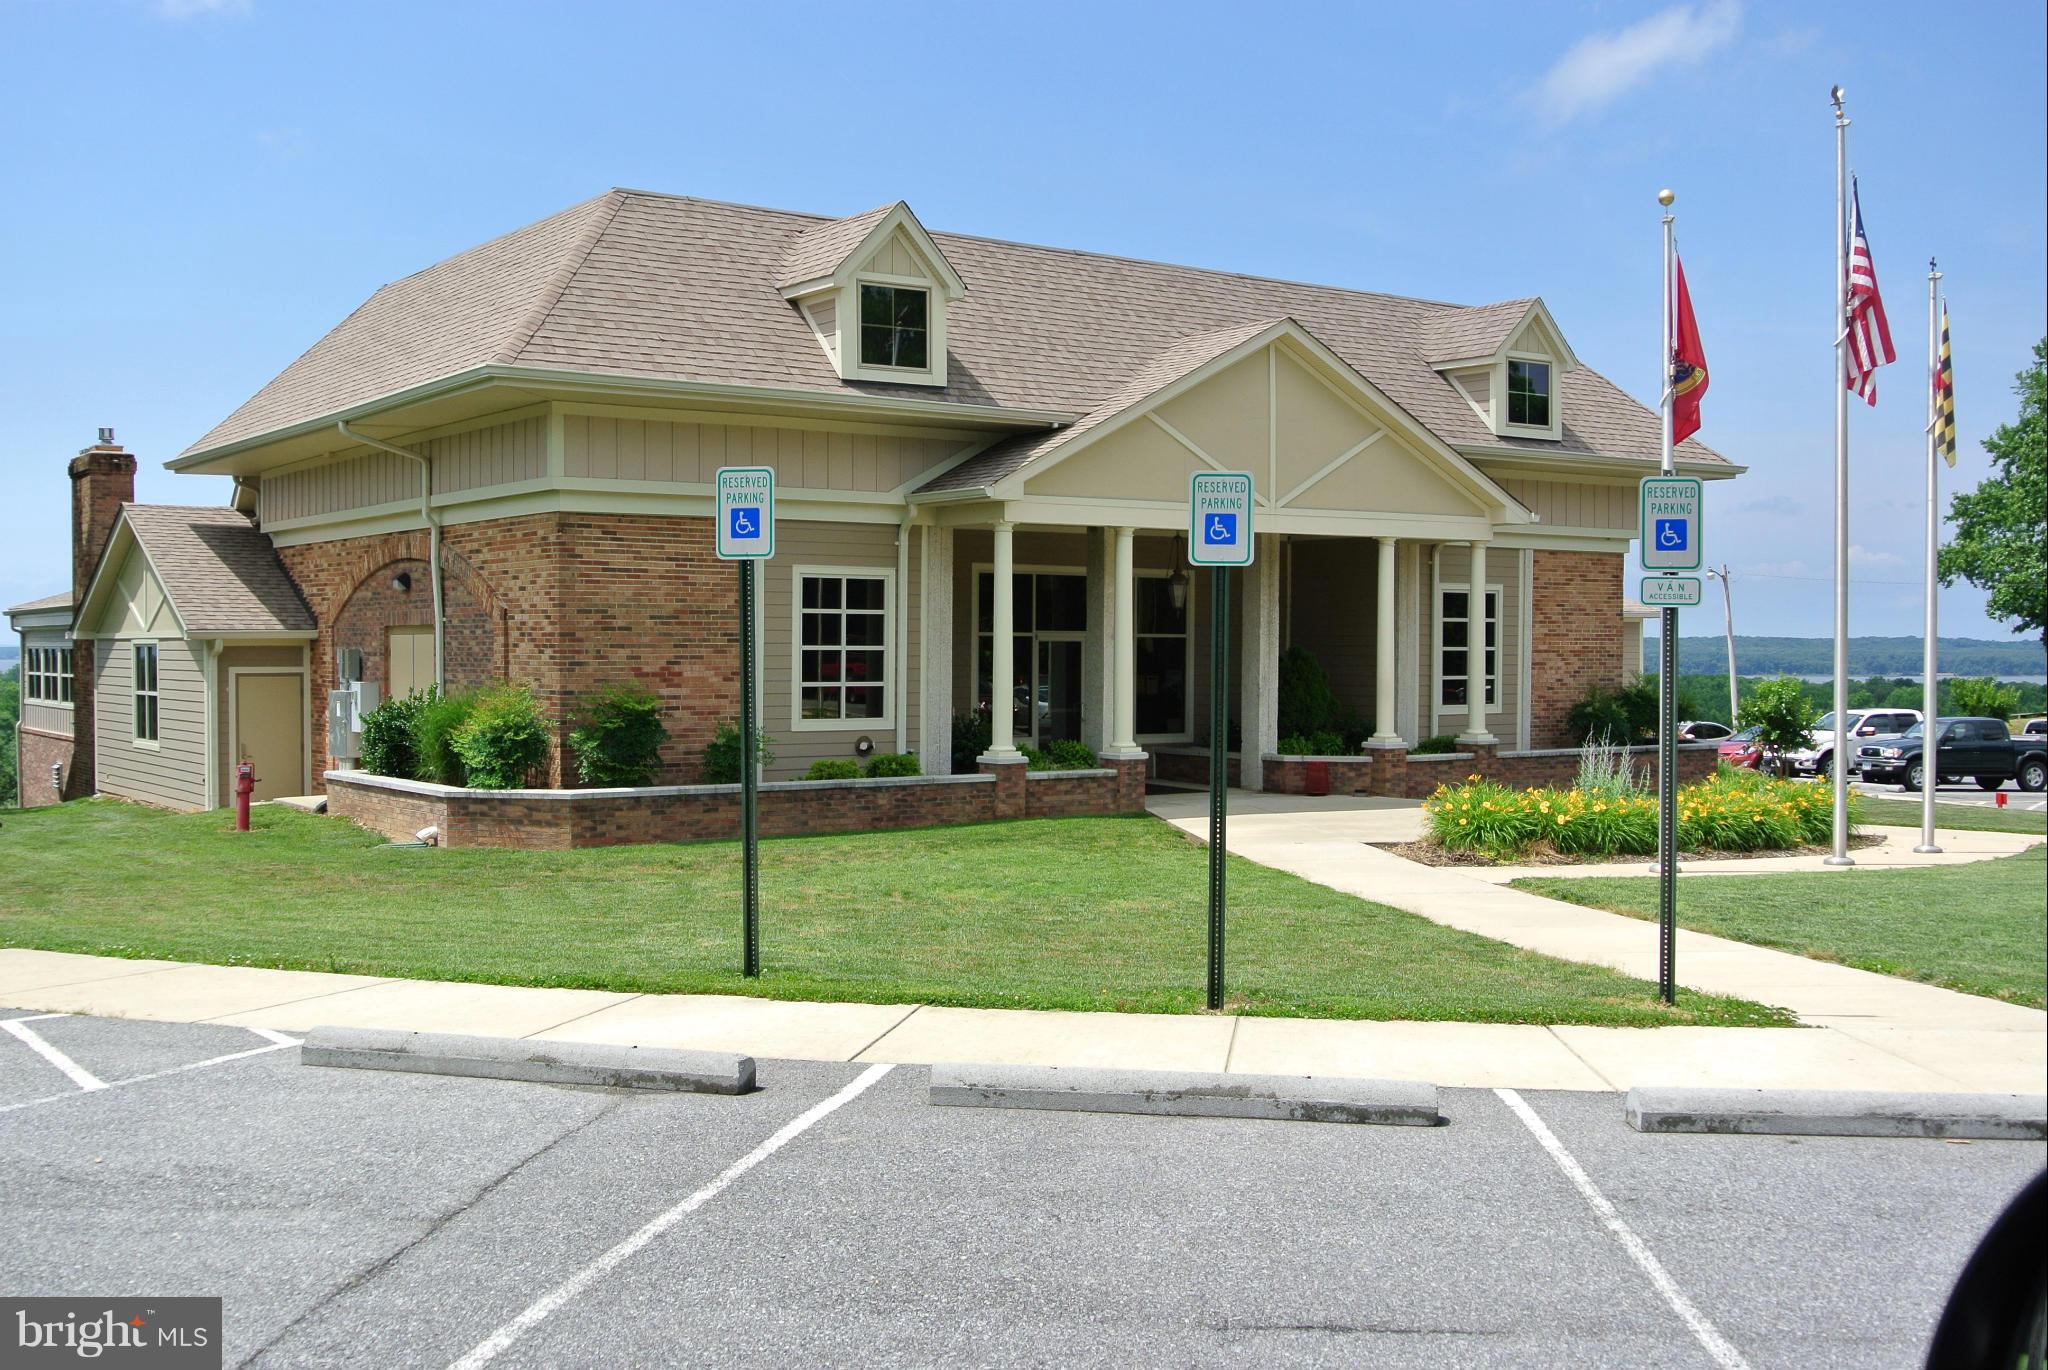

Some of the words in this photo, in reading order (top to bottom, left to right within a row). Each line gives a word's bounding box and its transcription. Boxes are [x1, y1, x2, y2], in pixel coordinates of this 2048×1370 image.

[722, 477, 768, 488] RESERVED
[1197, 481, 1247, 493] RESERVED
[726, 492, 764, 504] PARKING
[1647, 486, 1696, 498] RESERVED
[1201, 497, 1242, 509] PARKING
[1651, 503, 1692, 514] PARKING
[1657, 583, 1685, 591] VAN
